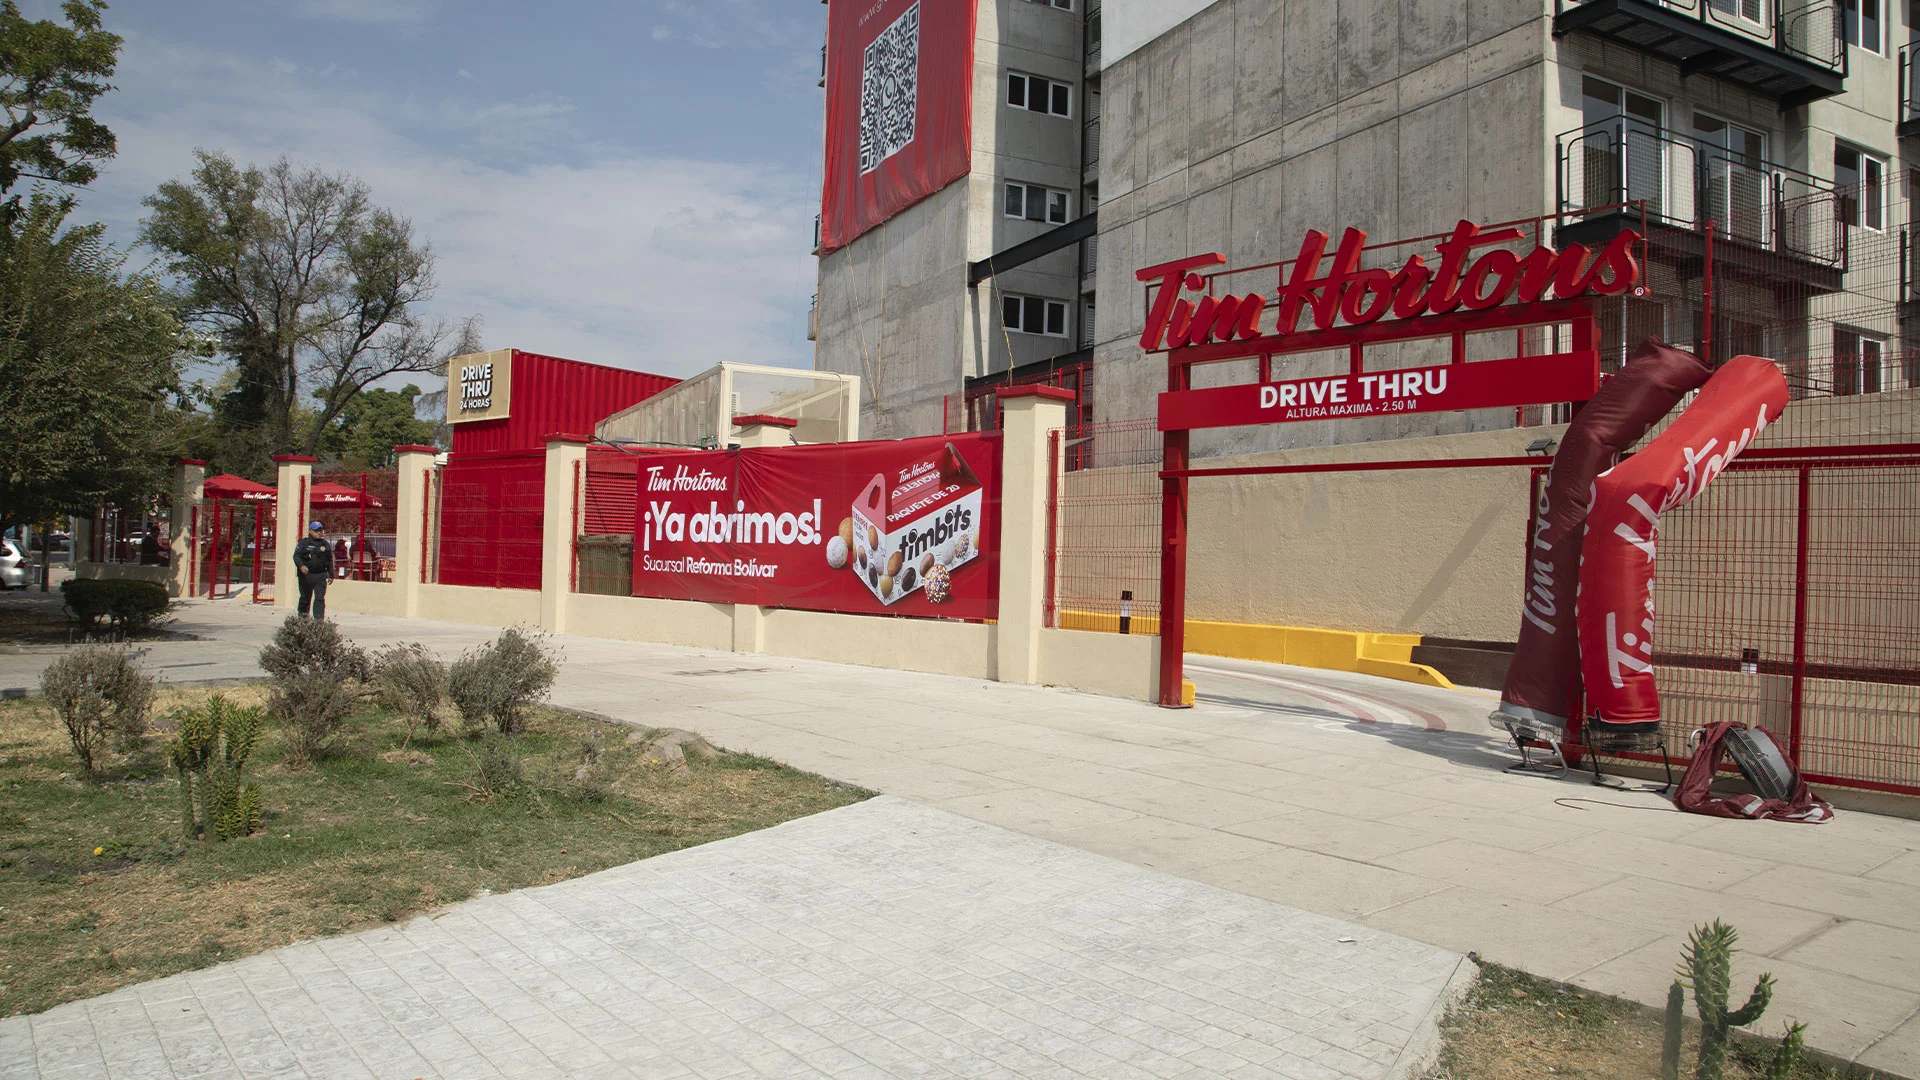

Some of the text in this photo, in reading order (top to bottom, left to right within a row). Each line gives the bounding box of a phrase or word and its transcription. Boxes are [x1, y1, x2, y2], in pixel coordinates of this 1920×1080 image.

[1136, 252, 1267, 351] Tim
[1276, 218, 1642, 336] Hortons
[461, 364, 492, 382] DRIVE
[460, 380, 491, 398] THRU
[1260, 368, 1447, 409] DRIVE THRU
[460, 398, 490, 410] 24 HORAS
[1286, 406, 1328, 419] ALTURA
[1329, 404, 1373, 416] MAXIMA
[1382, 400, 1404, 412] 2.50
[1407, 399, 1417, 410] M
[647, 464, 726, 492] Tim Hortons
[899, 460, 936, 484] Tim Hortons
[886, 484, 960, 522] PAQUETE DE 20
[643, 501, 686, 551] ¡Ya
[689, 498, 822, 545] abrimos!
[899, 504, 971, 562] timbits
[643, 555, 778, 578] Sucursal Reforma Bolívar
